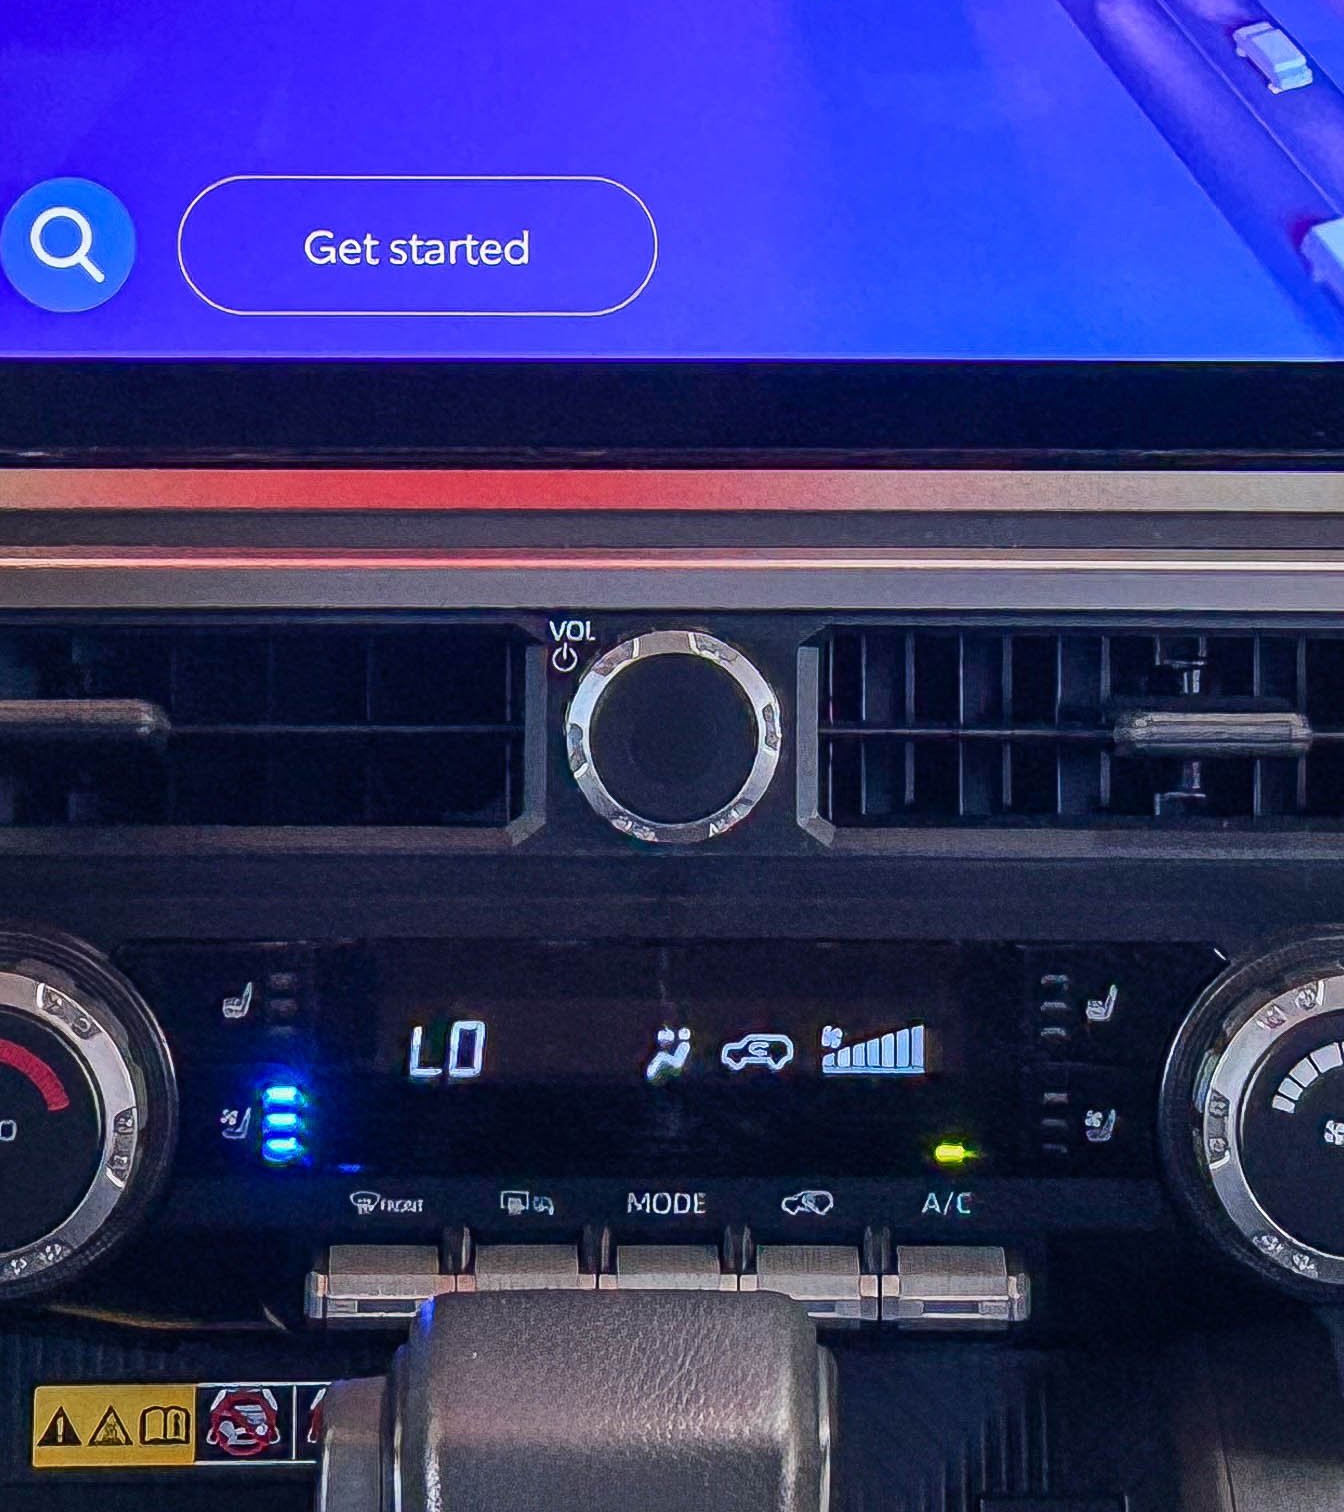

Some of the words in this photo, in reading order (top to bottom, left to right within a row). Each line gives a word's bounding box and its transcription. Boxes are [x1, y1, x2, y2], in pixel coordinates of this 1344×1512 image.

[304, 229, 379, 266] Get
[389, 229, 529, 266] started
[549, 620, 596, 641] VOL
[627, 1191, 706, 1215] MODE
[921, 1191, 973, 1215] A/C
